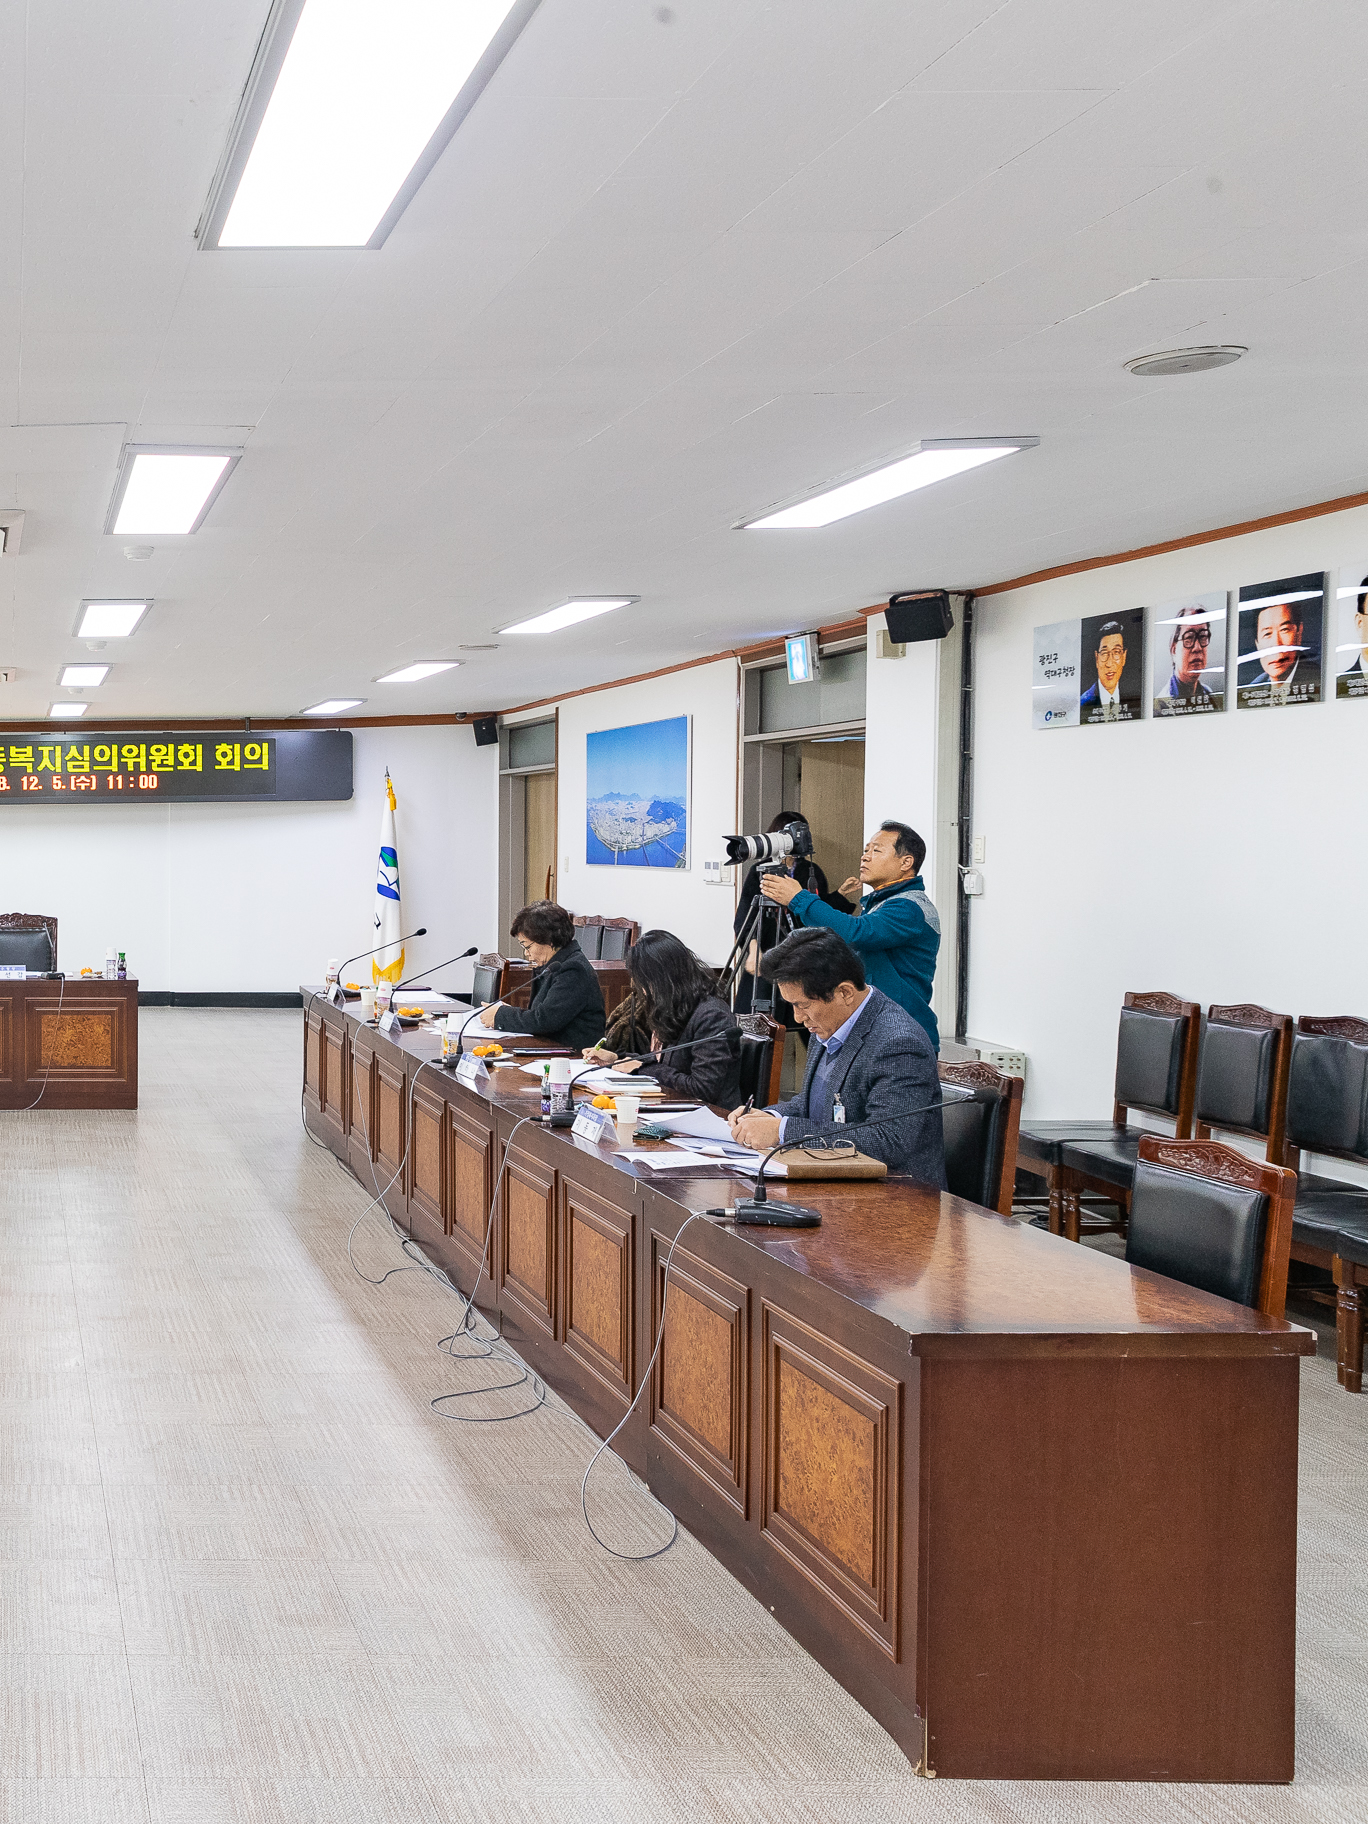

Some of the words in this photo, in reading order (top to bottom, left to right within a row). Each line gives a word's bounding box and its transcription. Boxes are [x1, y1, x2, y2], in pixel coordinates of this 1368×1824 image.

[1038, 653, 1059, 666] 광진구
[214, 743, 269, 771] 회의
[20, 775, 43, 790] 12.
